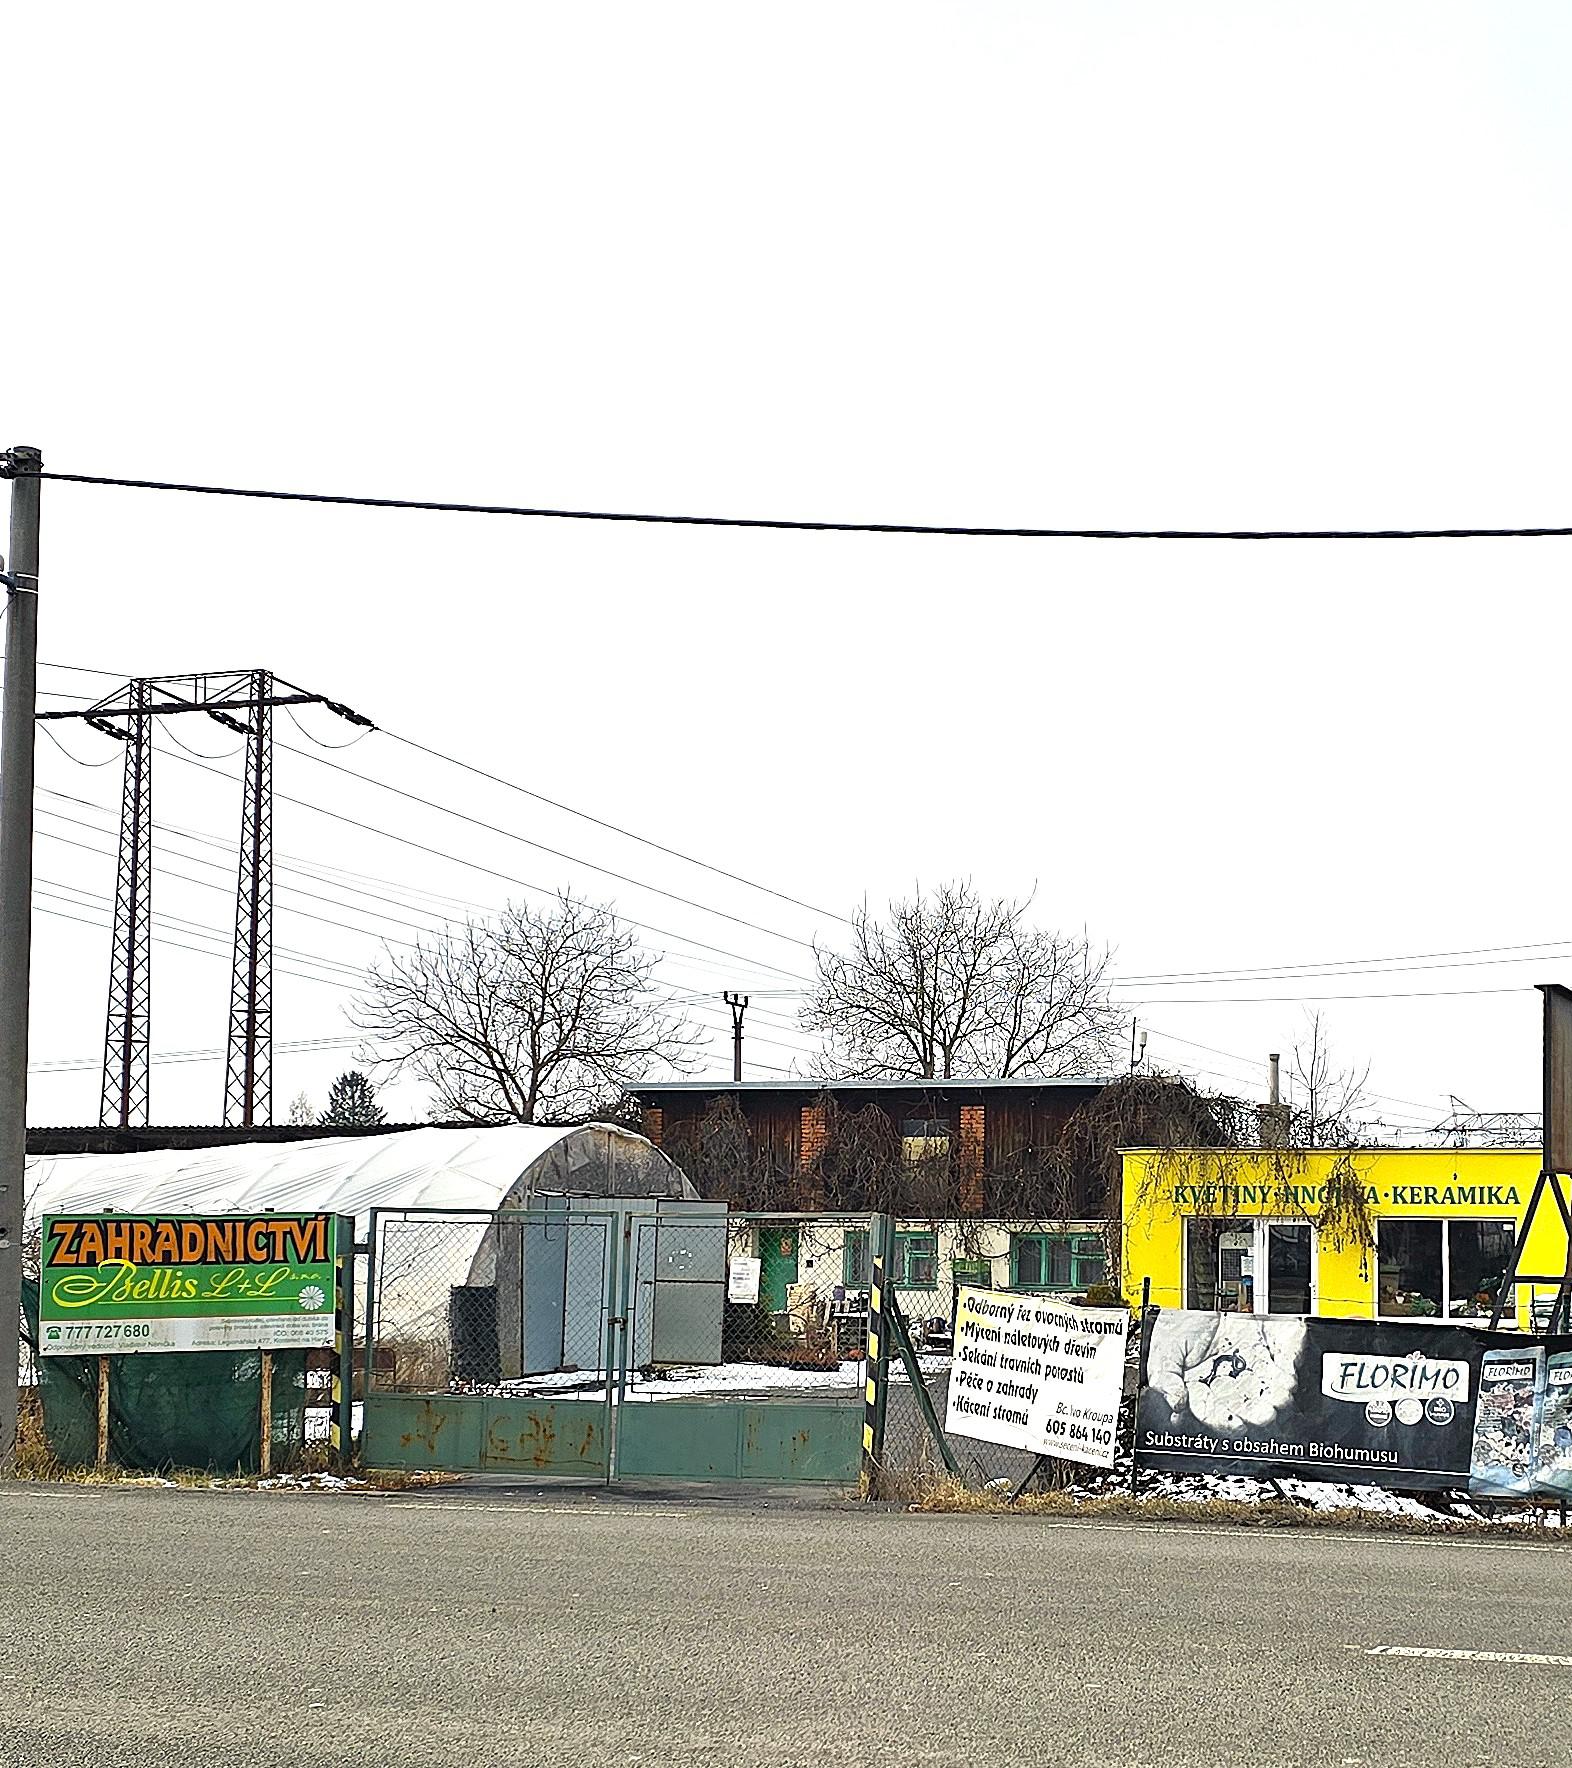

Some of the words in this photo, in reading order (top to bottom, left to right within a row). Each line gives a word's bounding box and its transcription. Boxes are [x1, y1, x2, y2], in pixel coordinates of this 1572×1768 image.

[1174, 1181, 1272, 1203] KVĚTINY
[1392, 1186, 1520, 1204] KERAMIKA
[51, 1214, 328, 1266] ZAHRADNICTVÍ
[53, 1259, 198, 1307] Bellis
[66, 1326, 92, 1339] 777
[95, 1325, 122, 1338] 727
[124, 1324, 150, 1337] 680
[968, 1297, 1015, 1323] Odborný
[1017, 1305, 1031, 1322] řez
[1035, 1311, 1078, 1332] ovocných
[1080, 1318, 1122, 1335] stromů
[965, 1321, 1001, 1342] Mýcení
[1004, 1329, 1060, 1354] náletových
[1064, 1339, 1096, 1359] dřevin
[962, 1346, 998, 1367] Sekání
[1000, 1354, 1042, 1376] travních
[1045, 1365, 1084, 1384] porostů
[1340, 1362, 1460, 1391] FLORIMO
[1488, 1366, 1530, 1377] FLORIMO
[960, 1371, 983, 1390] Péče
[987, 1380, 993, 1392] o
[996, 1380, 1038, 1404] zahrady
[956, 1395, 992, 1417] Kácení
[993, 1405, 1029, 1425] stromů
[1083, 1408, 1114, 1426] Kroupa
[1046, 1419, 1067, 1436] 605
[1069, 1424, 1088, 1441] 864
[1092, 1428, 1111, 1445] 140
[1146, 1431, 1218, 1453] Substráty
[1222, 1438, 1229, 1451] s
[1233, 1438, 1304, 1457] obsahem
[1309, 1442, 1399, 1464] Biohumusu
